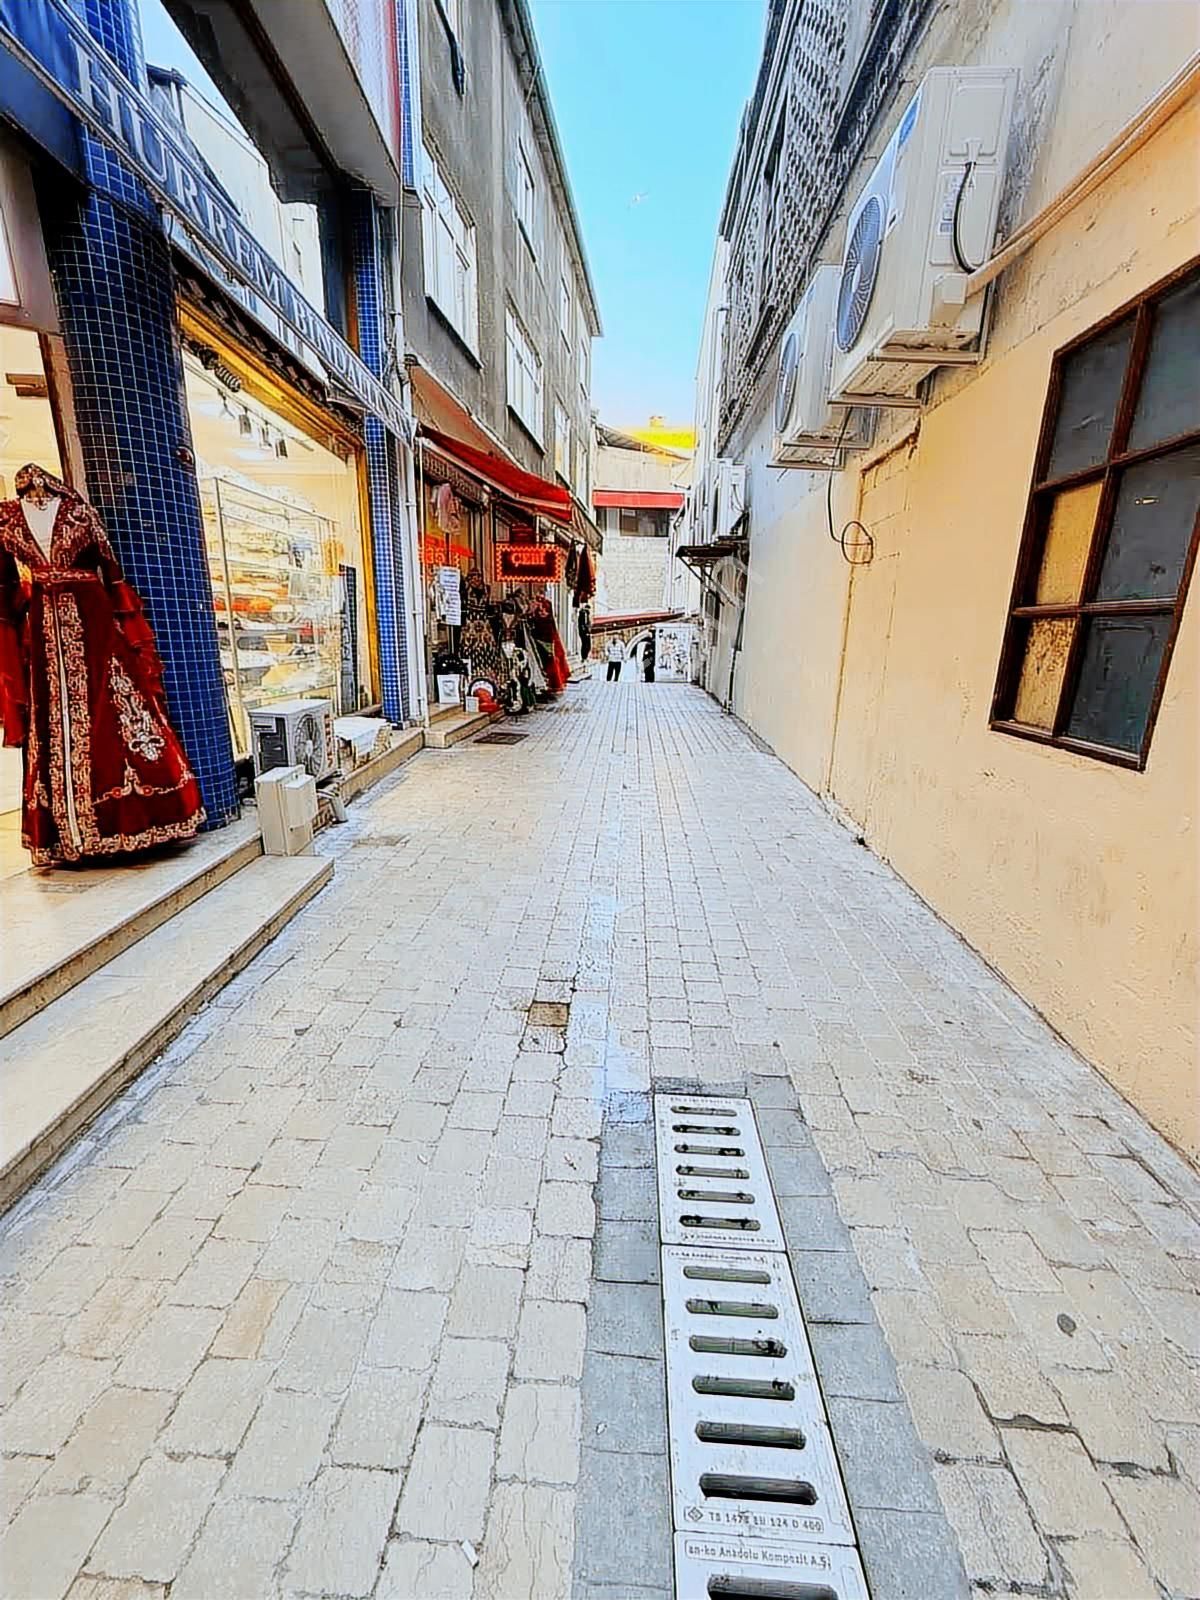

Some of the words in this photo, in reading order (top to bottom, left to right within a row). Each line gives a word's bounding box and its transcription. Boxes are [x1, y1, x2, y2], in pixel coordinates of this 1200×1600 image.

[771, 1517, 788, 1528] 124
[803, 1520, 822, 1532] 400
[719, 1545, 759, 1561] Anadolu
[761, 1549, 809, 1566] Kompozit
